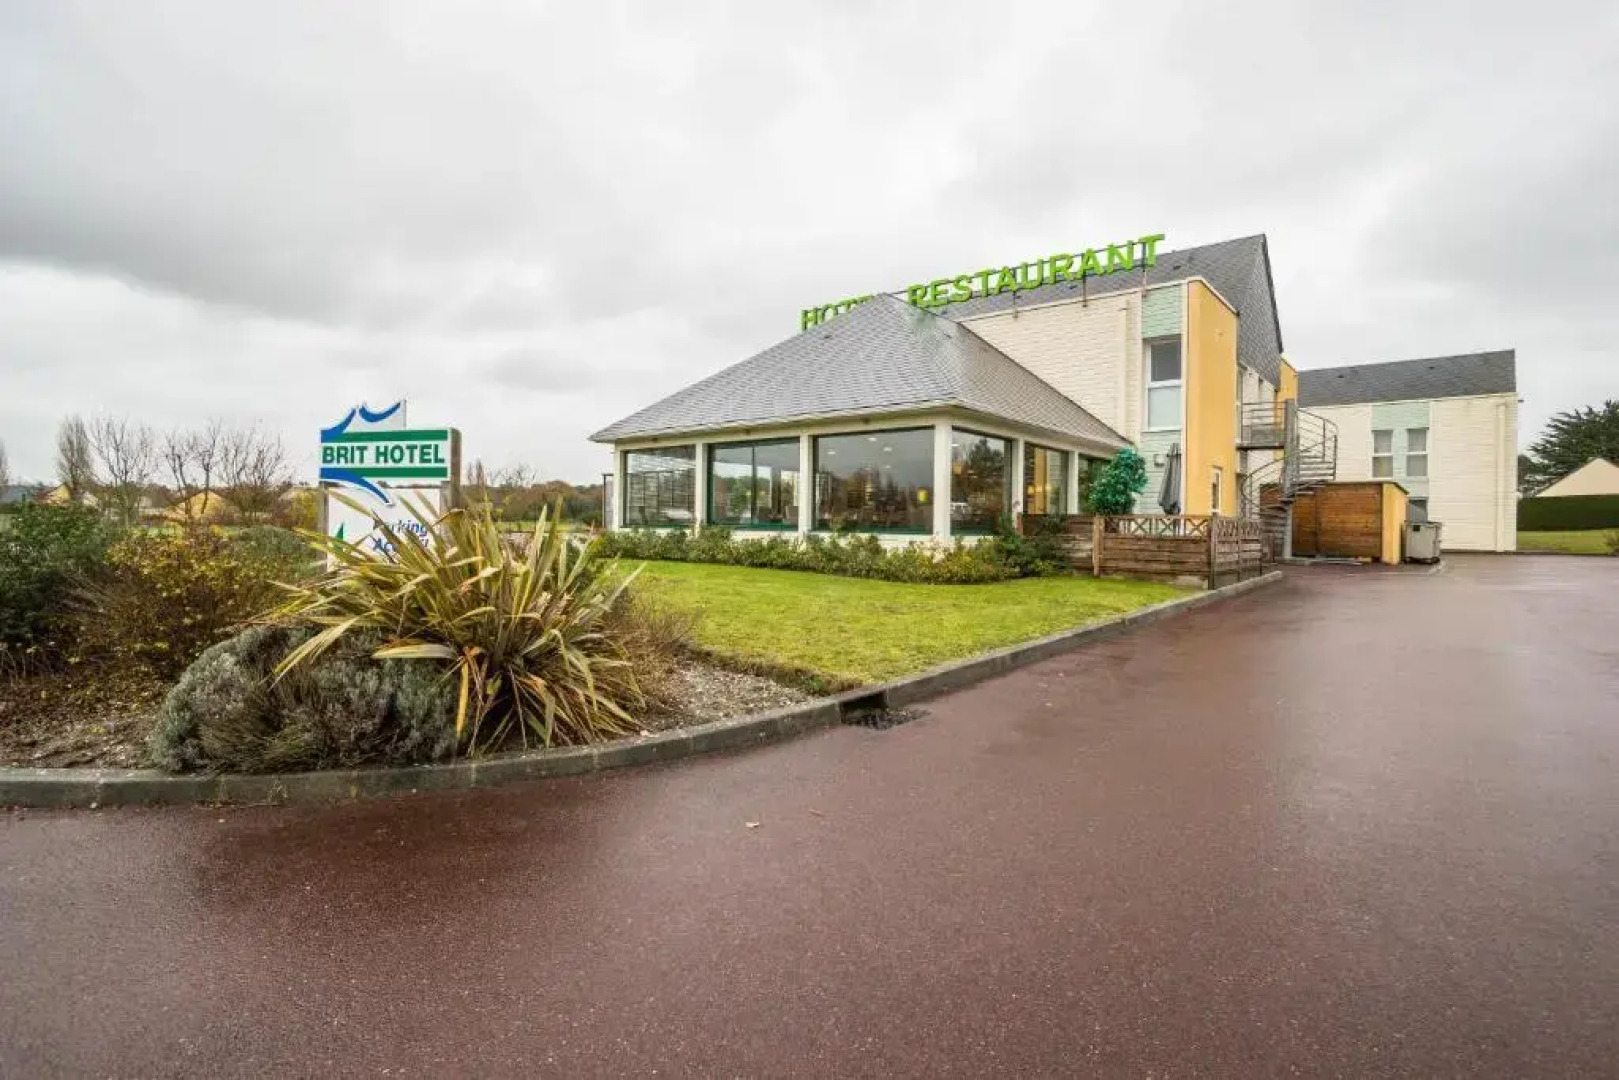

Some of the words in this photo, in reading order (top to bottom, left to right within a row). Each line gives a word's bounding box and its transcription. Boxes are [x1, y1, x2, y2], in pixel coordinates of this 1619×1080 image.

[906, 233, 1165, 309] RESTAURANT
[322, 445, 368, 463] BRIT
[375, 444, 445, 463] HOTEL
